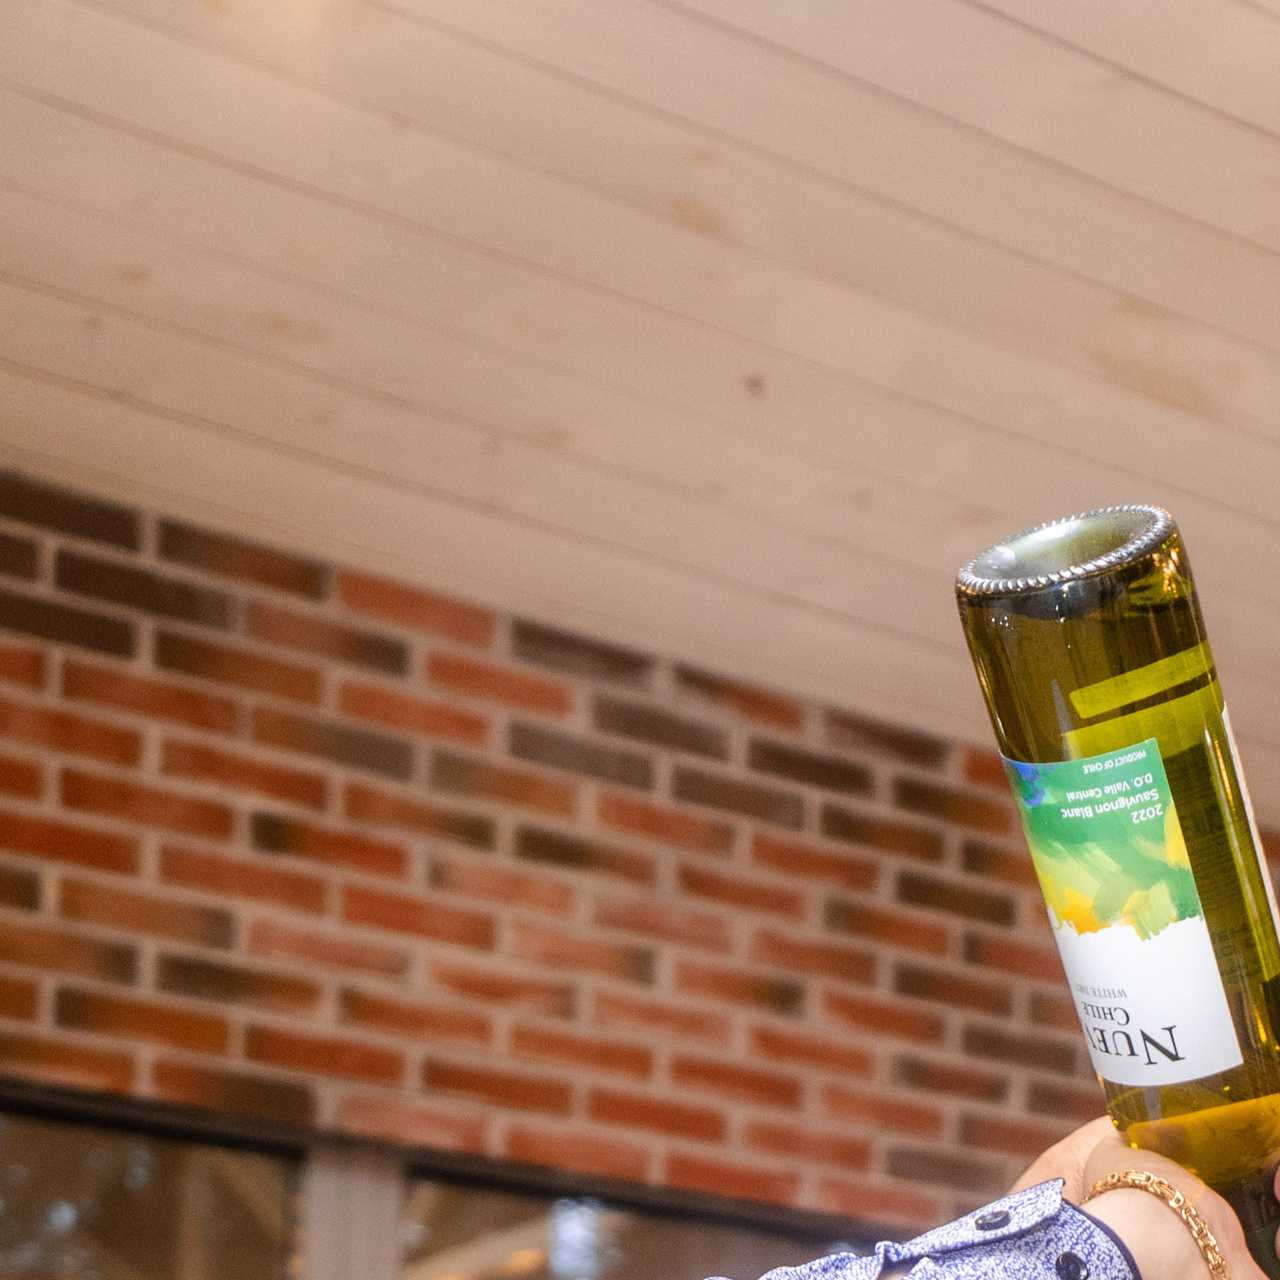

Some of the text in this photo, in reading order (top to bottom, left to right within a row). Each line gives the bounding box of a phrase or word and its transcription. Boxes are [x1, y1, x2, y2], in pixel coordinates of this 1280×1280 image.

[1082, 749, 1147, 774] PRODUCT OF CHILE
[1066, 773, 1154, 803] D.O. Valle Central
[1060, 788, 1159, 819] Sauvignon Blanc
[1130, 803, 1164, 824] 2022
[1089, 987, 1128, 999] WHITE
[1080, 1001, 1130, 1026] CHILE
